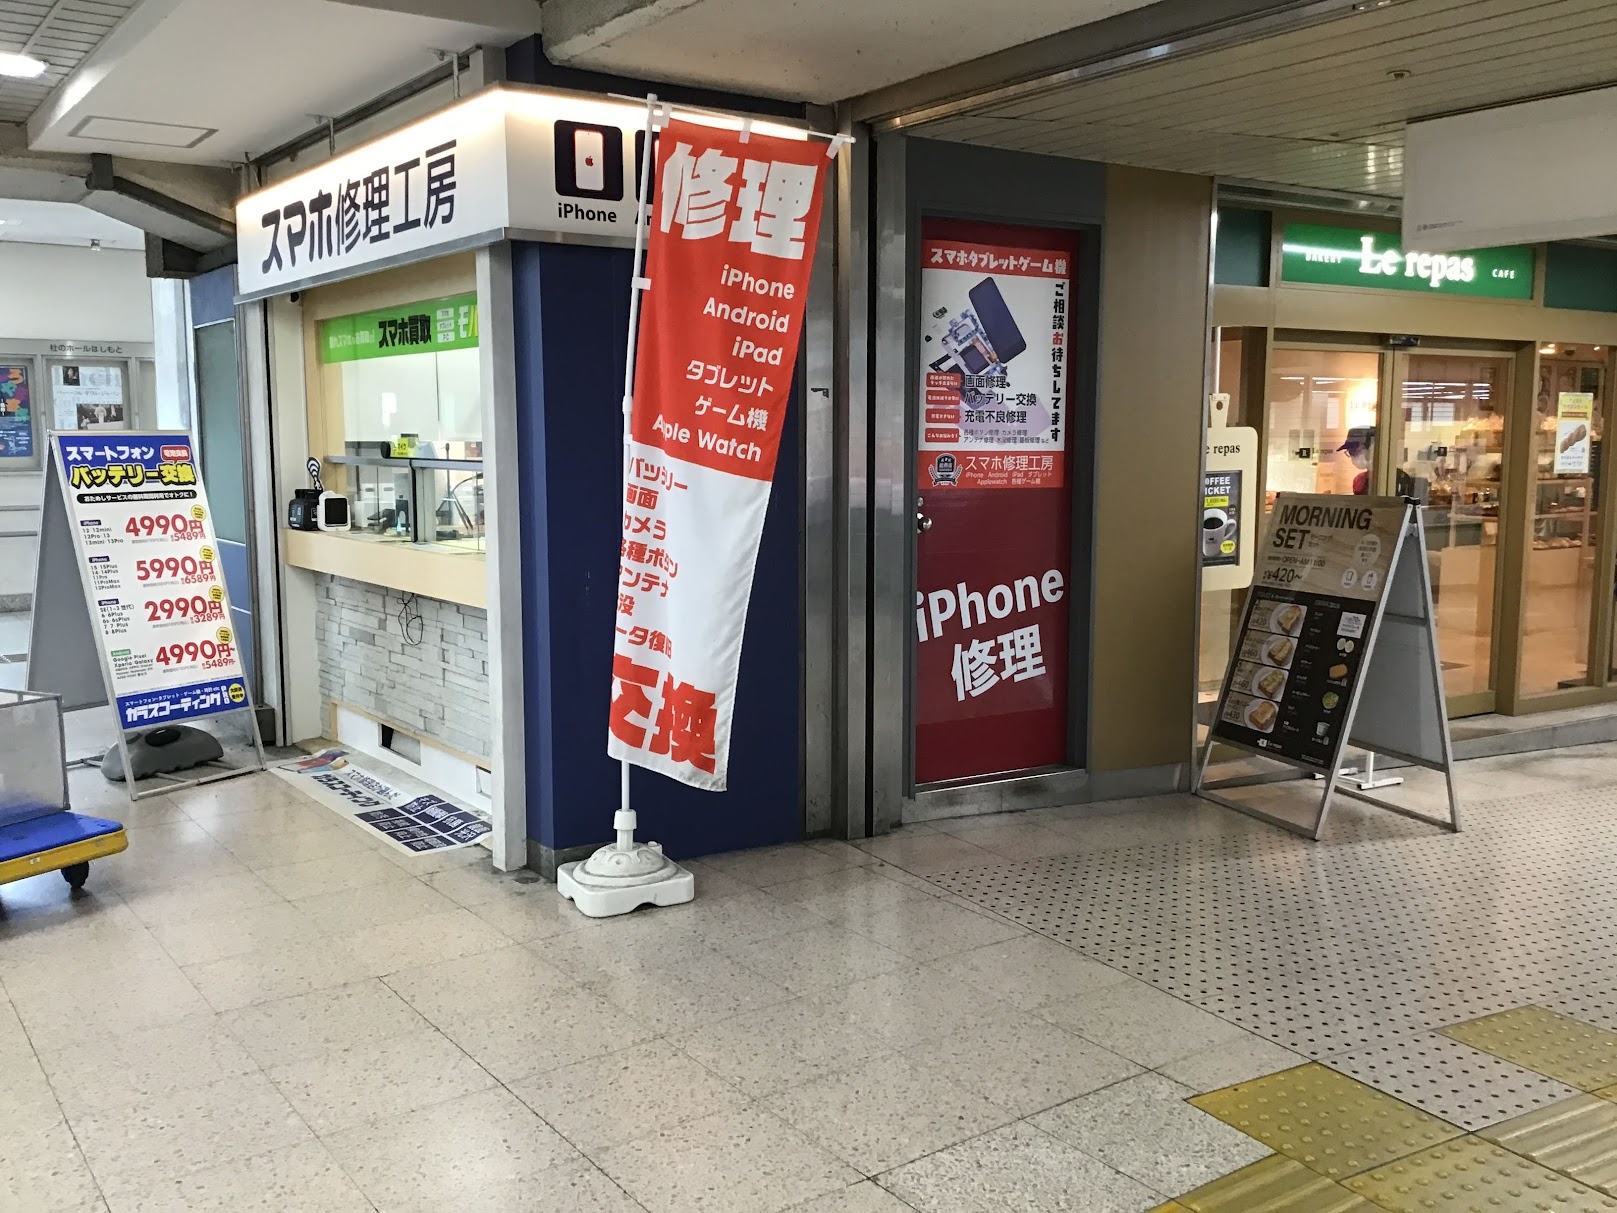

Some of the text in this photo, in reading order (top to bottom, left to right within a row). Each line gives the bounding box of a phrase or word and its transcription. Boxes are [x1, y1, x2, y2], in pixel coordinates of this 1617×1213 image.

[262, 140, 457, 274] スマホ修理工房
[558, 202, 617, 223] iPhone
[660, 142, 818, 260] 修理
[1359, 236, 1397, 275] Le
[1404, 252, 1474, 287] repas
[720, 263, 795, 300] iPhone
[702, 297, 790, 333] Android
[378, 314, 432, 348] スマホ買取
[731, 335, 783, 366] iPad
[1050, 281, 1065, 442] ご相談お待ちしてます
[686, 360, 774, 397] タブレット
[964, 375, 1006, 389] 画面修理
[964, 390, 1037, 406] バッテリー交換
[694, 395, 769, 432] ゲーム機
[964, 410, 1027, 423] 充電不良修理
[65, 445, 154, 461] スマートフォン
[697, 429, 762, 462] Watch
[1213, 444, 1241, 456] repas
[71, 463, 197, 489] バッテリー交換
[965, 455, 1054, 471] スマホ修理工房
[125, 513, 204, 537] 4990円
[1280, 505, 1373, 530] MORNING
[1272, 527, 1310, 550] SET
[136, 556, 214, 581] 5990円
[144, 595, 223, 622] 2990円
[916, 569, 1064, 643] iPhone
[951, 623, 1047, 702] 修理
[125, 693, 220, 723] ガラスコーティング
